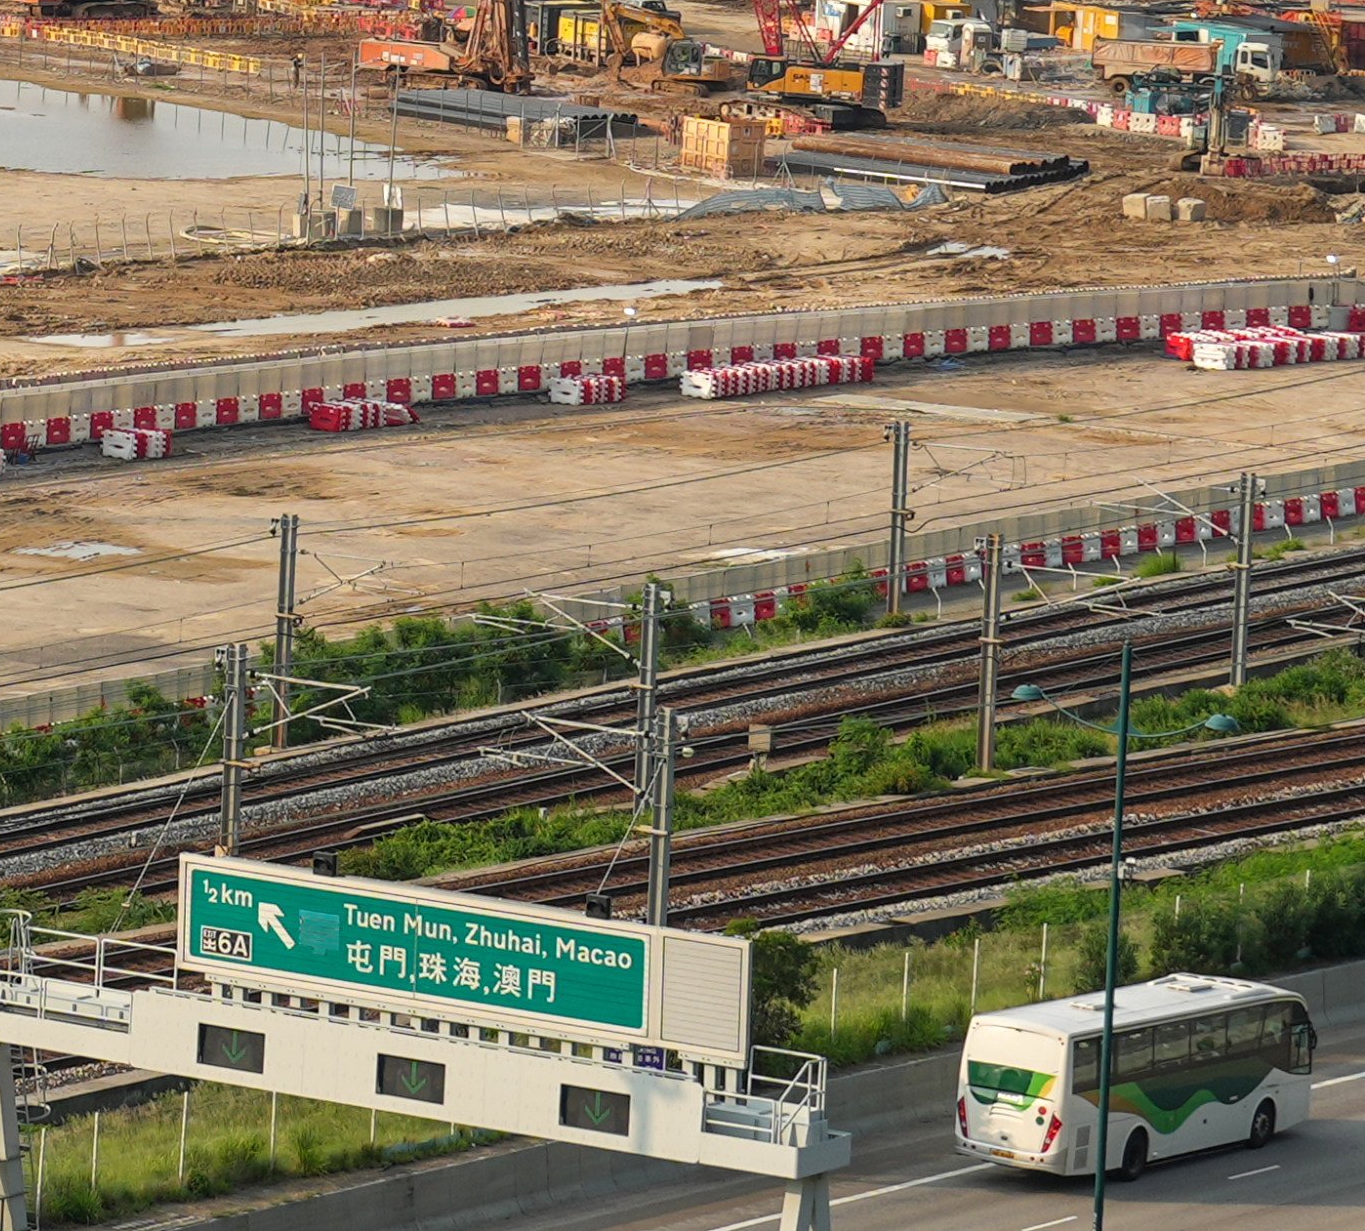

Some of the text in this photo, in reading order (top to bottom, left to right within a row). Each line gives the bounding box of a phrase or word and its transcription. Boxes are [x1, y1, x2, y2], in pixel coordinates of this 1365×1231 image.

[218, 931, 248, 957] 6A
[343, 903, 632, 969] Tuen Mun, Zhuhai, Macao
